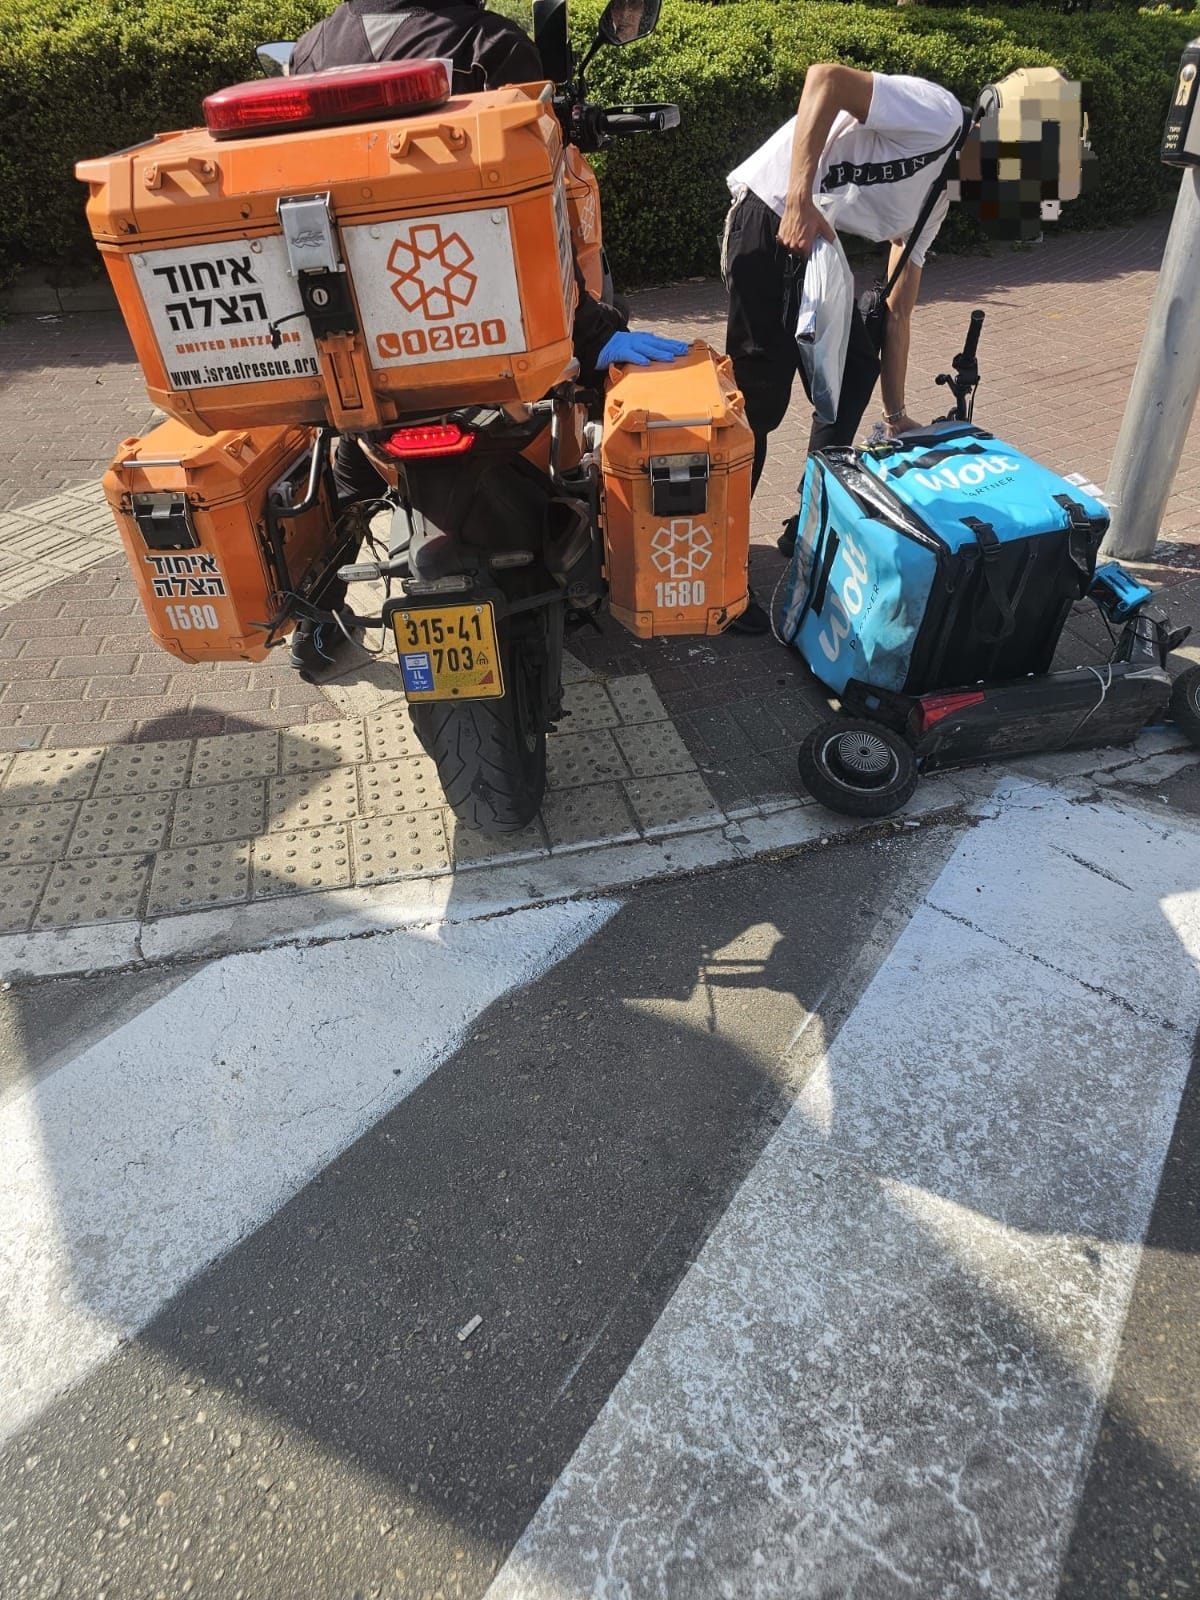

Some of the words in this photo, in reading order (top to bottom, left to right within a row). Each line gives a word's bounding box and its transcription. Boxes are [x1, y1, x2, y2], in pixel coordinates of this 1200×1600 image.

[152, 256, 257, 294] איחוד
[165, 293, 268, 331] הצלה
[175, 339, 226, 355] UNITED
[229, 331, 301, 348] HATZAAH
[404, 320, 504, 354] 1221
[170, 356, 320, 387] www.israelrescue.org
[914, 455, 1020, 492] Wolt
[144, 553, 221, 575] איחוד
[152, 574, 227, 597] הצלה
[654, 580, 706, 608] 1580
[818, 531, 869, 662] Wolt
[165, 604, 219, 630] 1580
[432, 646, 474, 674] 703
[412, 670, 425, 680] IL
